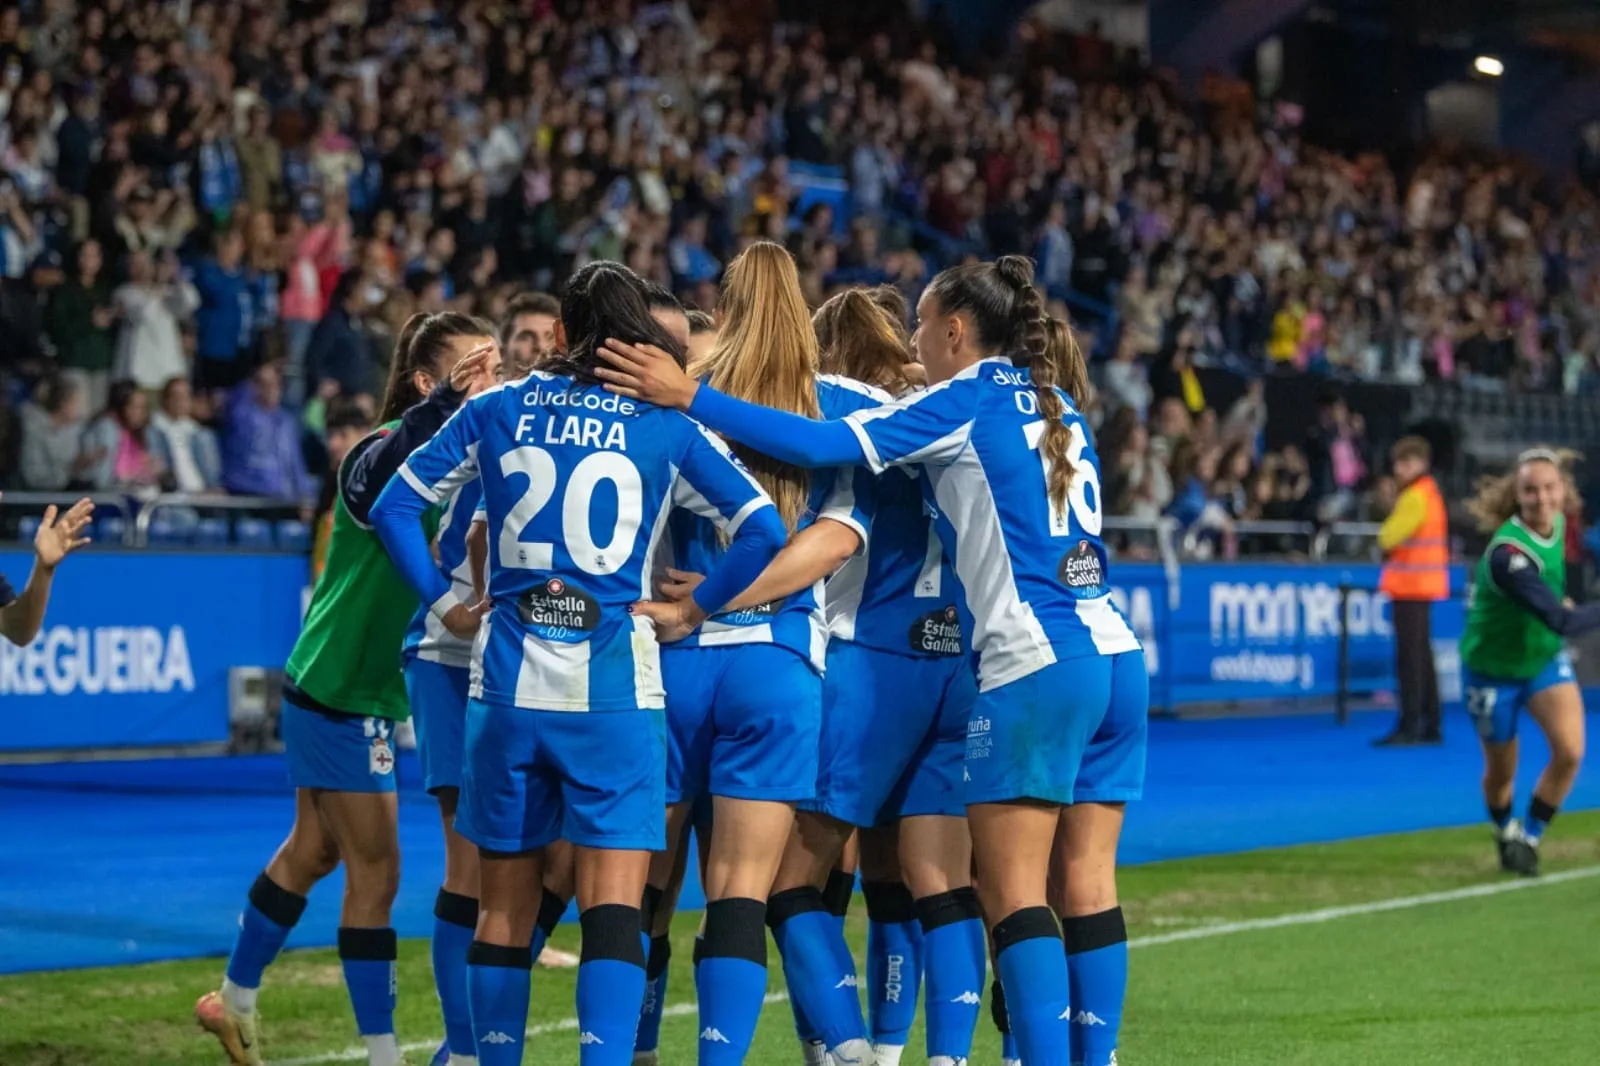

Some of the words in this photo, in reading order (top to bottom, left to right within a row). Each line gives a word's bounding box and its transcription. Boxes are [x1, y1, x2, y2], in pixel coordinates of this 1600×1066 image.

[514, 413, 536, 443] F.
[545, 415, 627, 451] LARA
[1022, 420, 1102, 537] 16
[498, 445, 643, 576] 20
[530, 593, 586, 612] Estrella
[531, 606, 583, 628] Galicia
